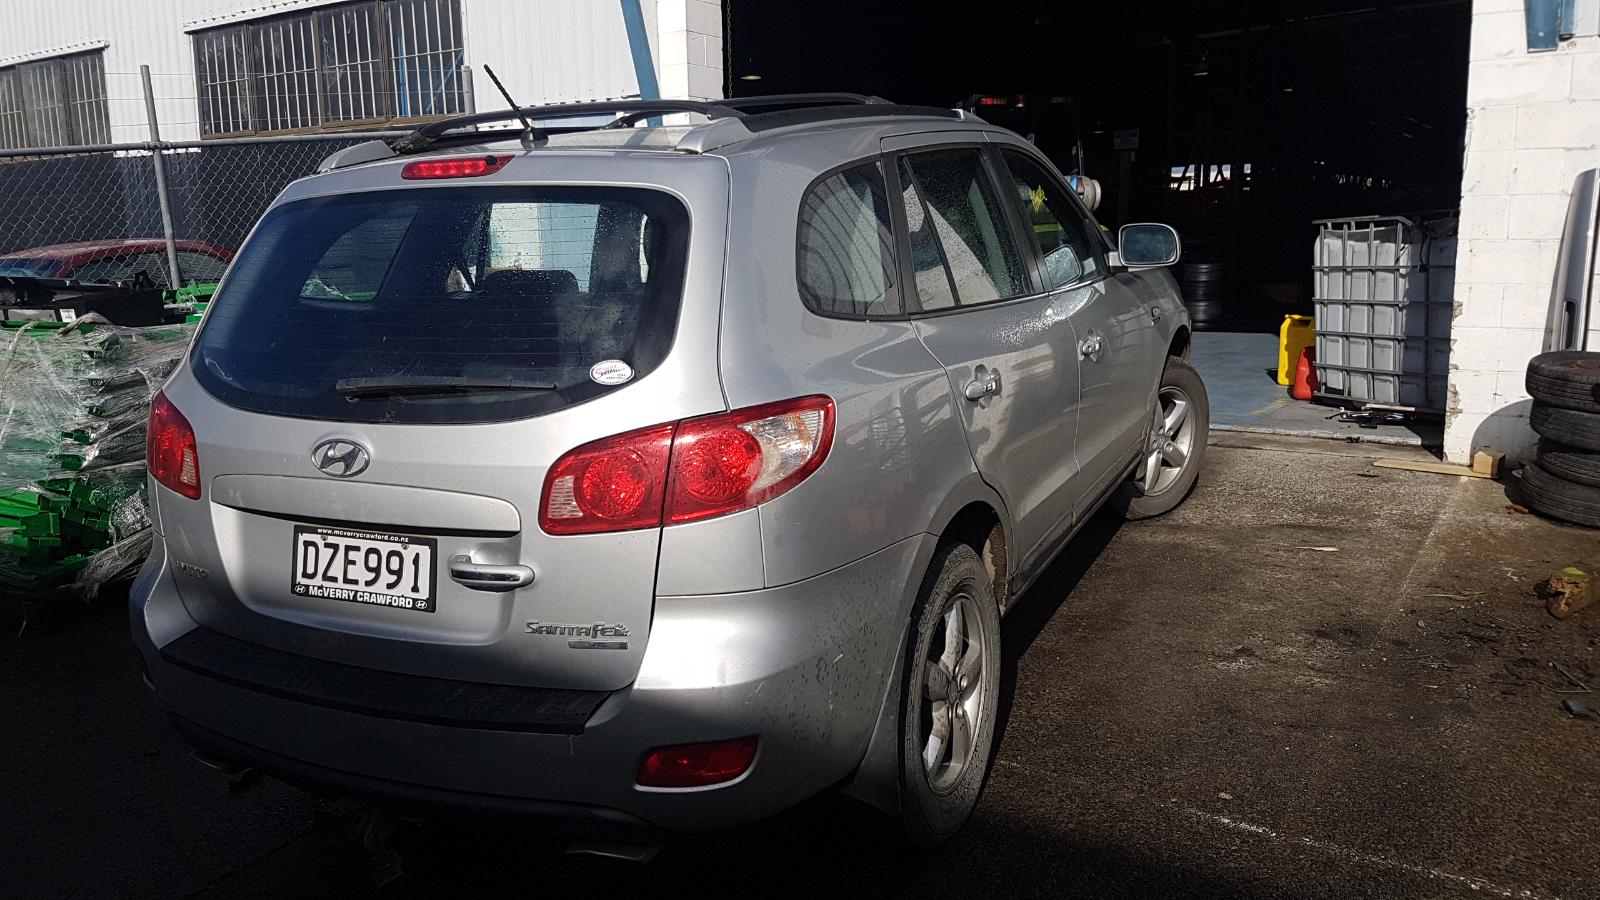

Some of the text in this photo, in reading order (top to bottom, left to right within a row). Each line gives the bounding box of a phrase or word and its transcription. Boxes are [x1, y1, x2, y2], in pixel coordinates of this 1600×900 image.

[317, 528, 409, 542] www.mcverrycrawford.co.nz
[301, 540, 420, 593] DZE991
[308, 586, 413, 609] McVERRY CRAWFORD
